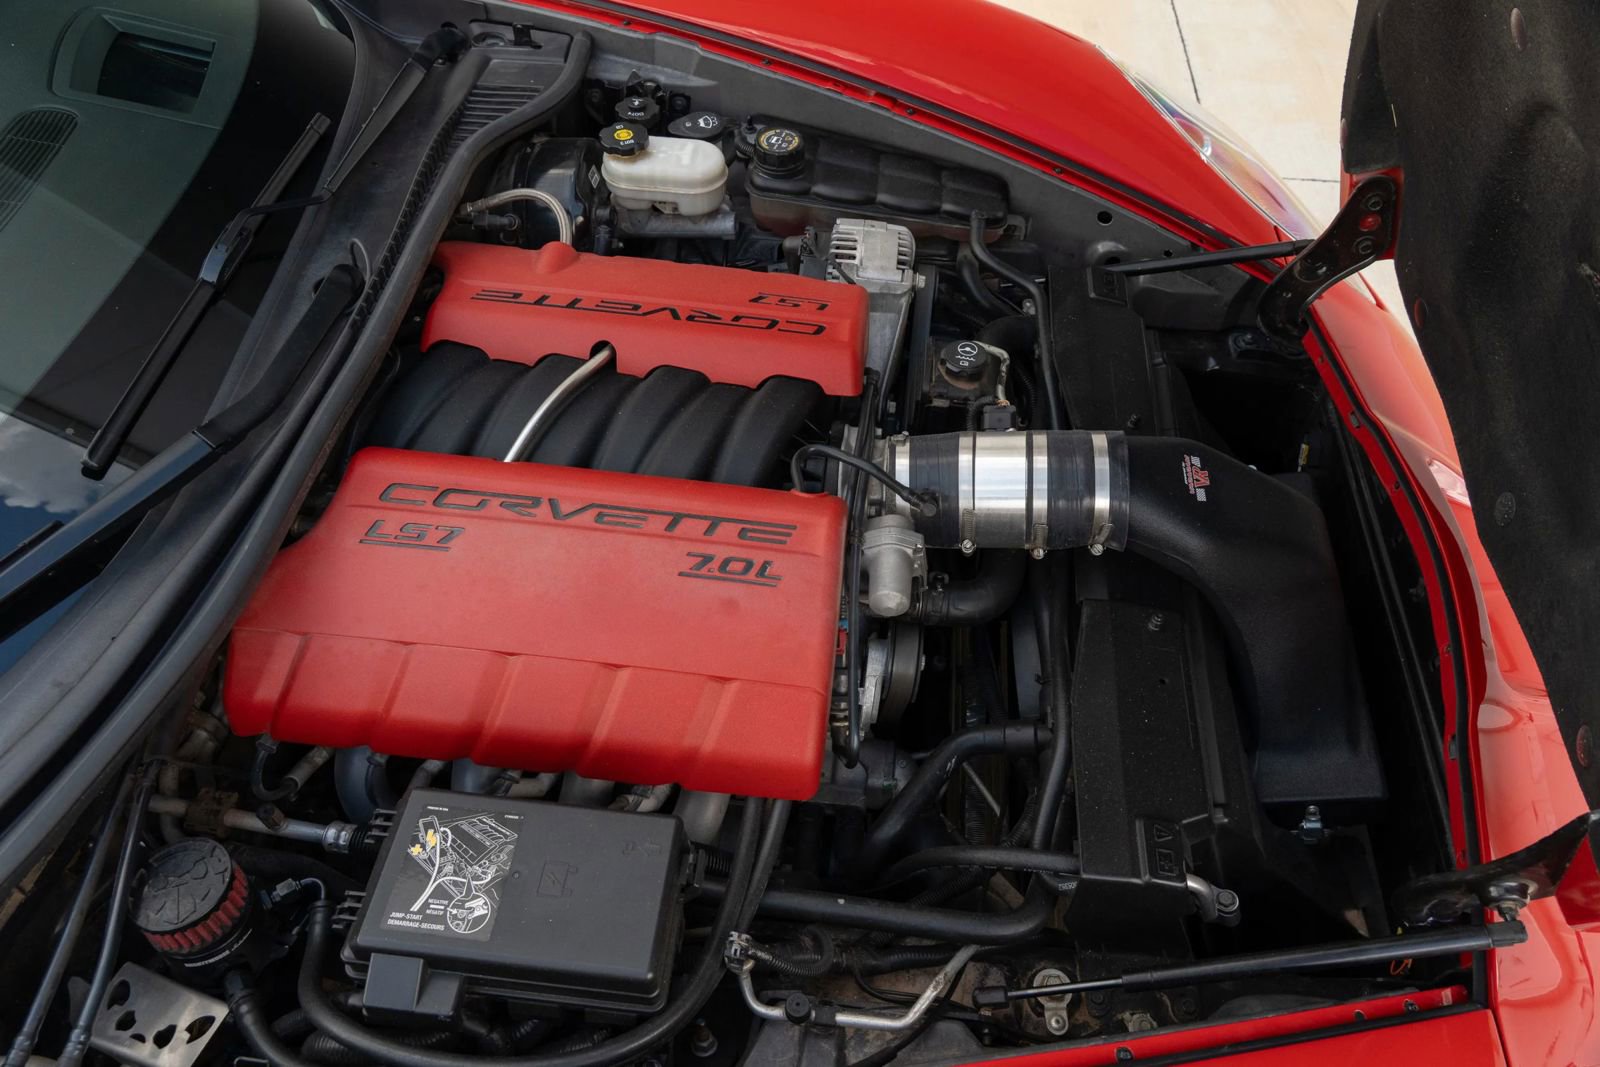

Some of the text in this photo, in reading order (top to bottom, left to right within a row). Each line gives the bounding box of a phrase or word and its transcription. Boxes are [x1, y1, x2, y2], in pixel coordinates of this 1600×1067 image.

[470, 289, 828, 336] CORVETTE
[749, 295, 831, 312] LS7
[378, 482, 798, 545] CORVETTE
[364, 519, 466, 546] LS7
[685, 551, 783, 581] 7.0L
[390, 912, 423, 920] JUMP-START
